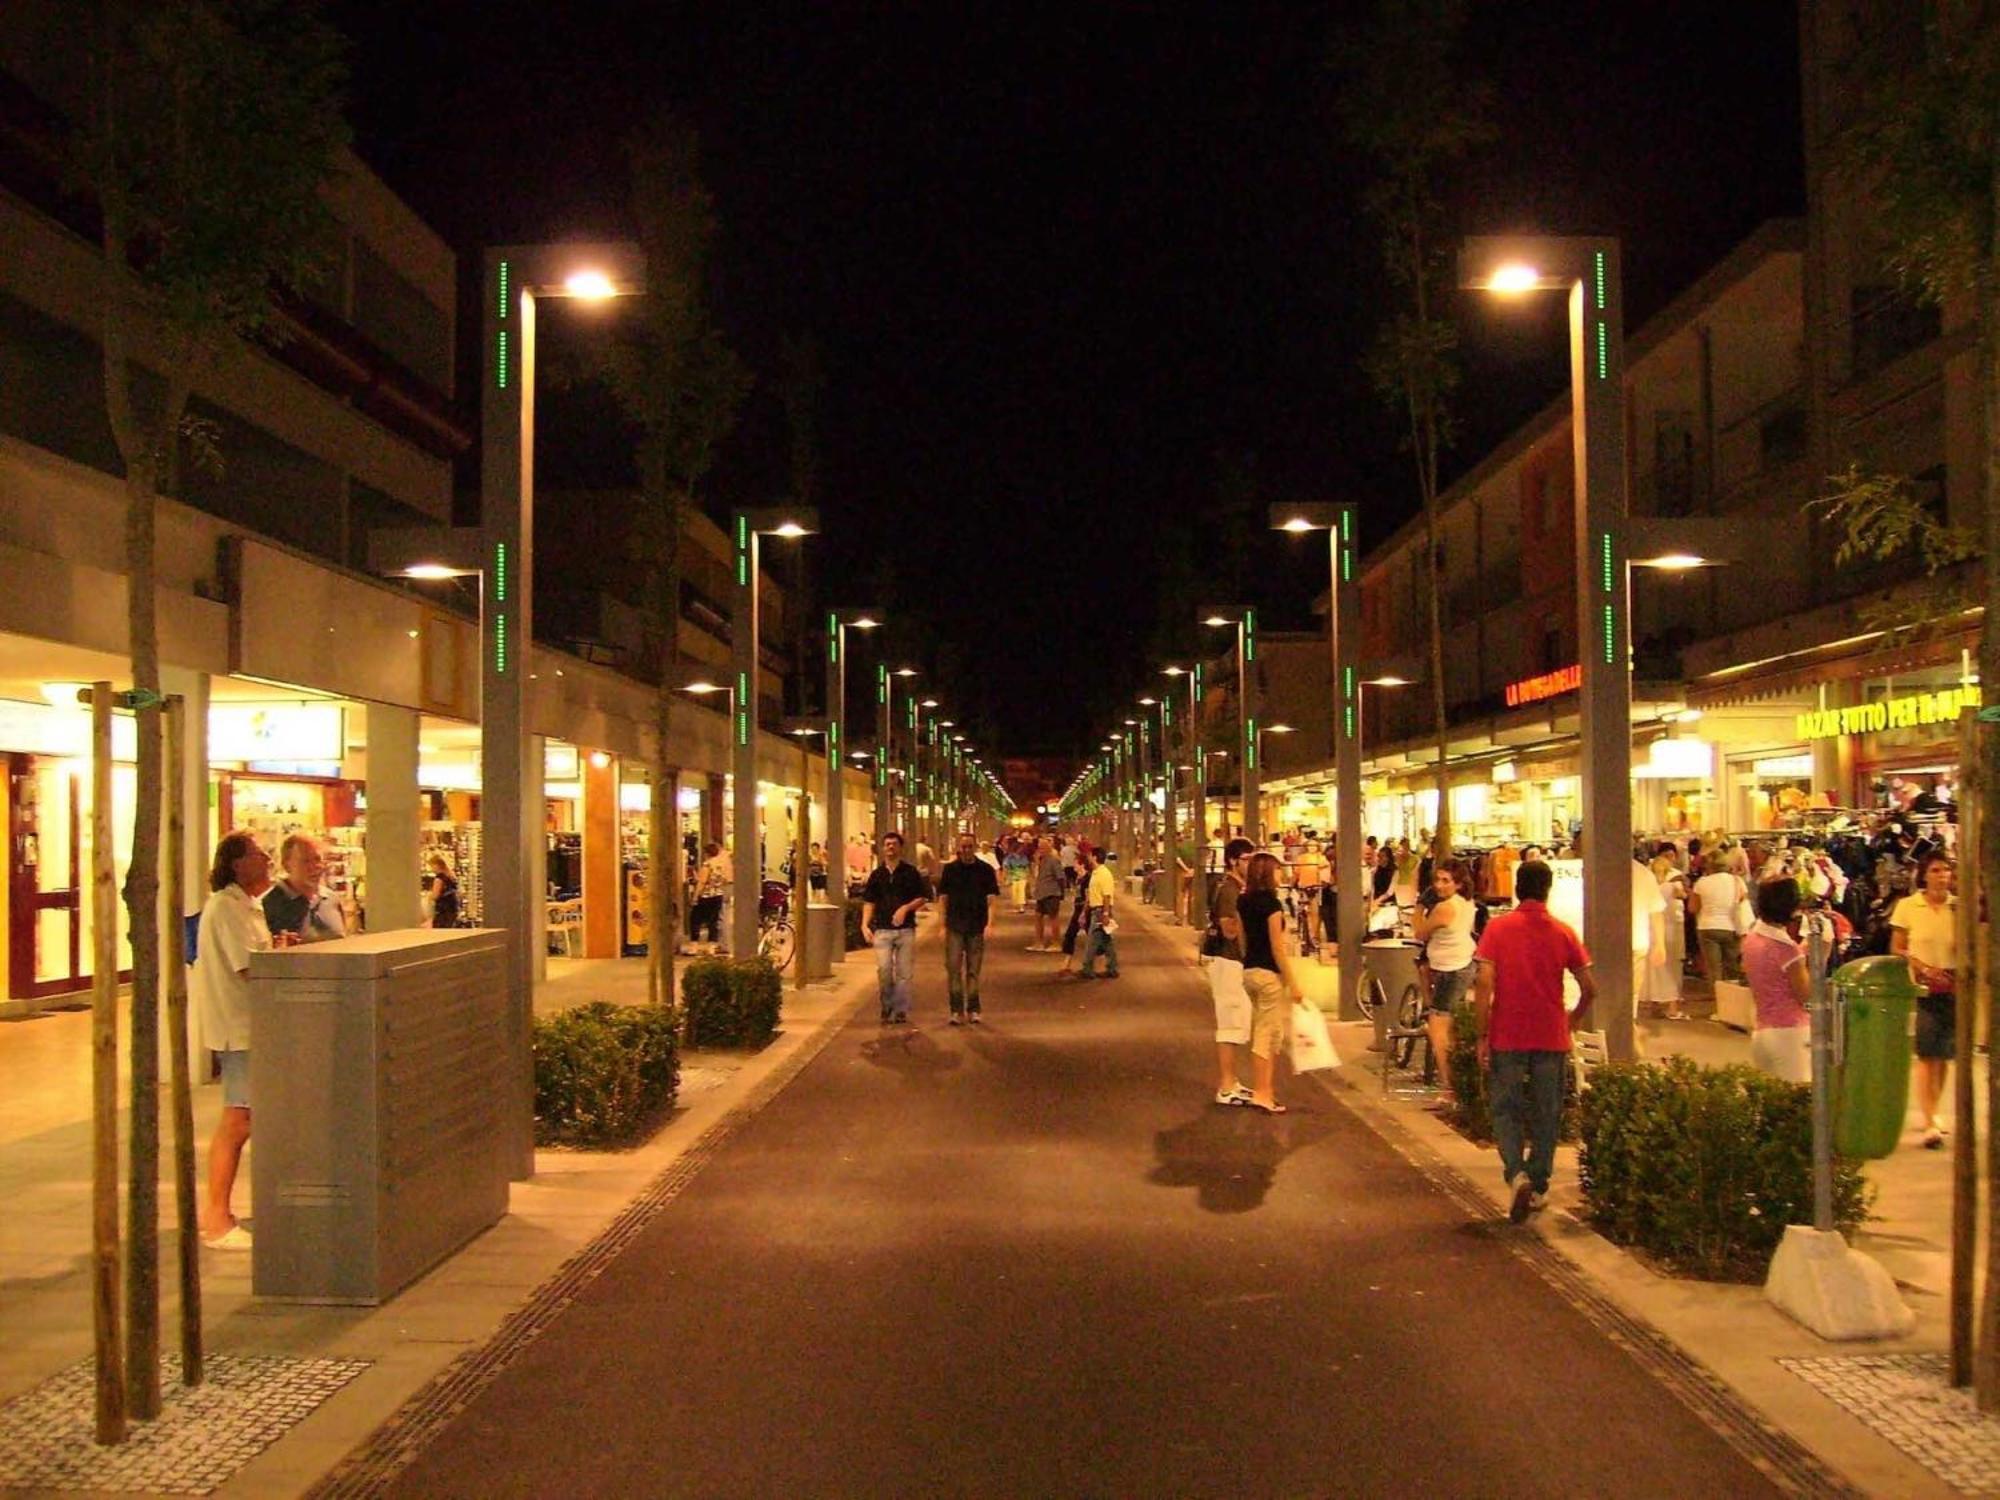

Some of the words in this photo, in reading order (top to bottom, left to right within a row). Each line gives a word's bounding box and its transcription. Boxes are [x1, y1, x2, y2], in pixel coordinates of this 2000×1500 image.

[1796, 709, 1840, 740] BAZAR
[1841, 702, 1886, 735] TUTTO
[1887, 696, 1917, 728] PER
